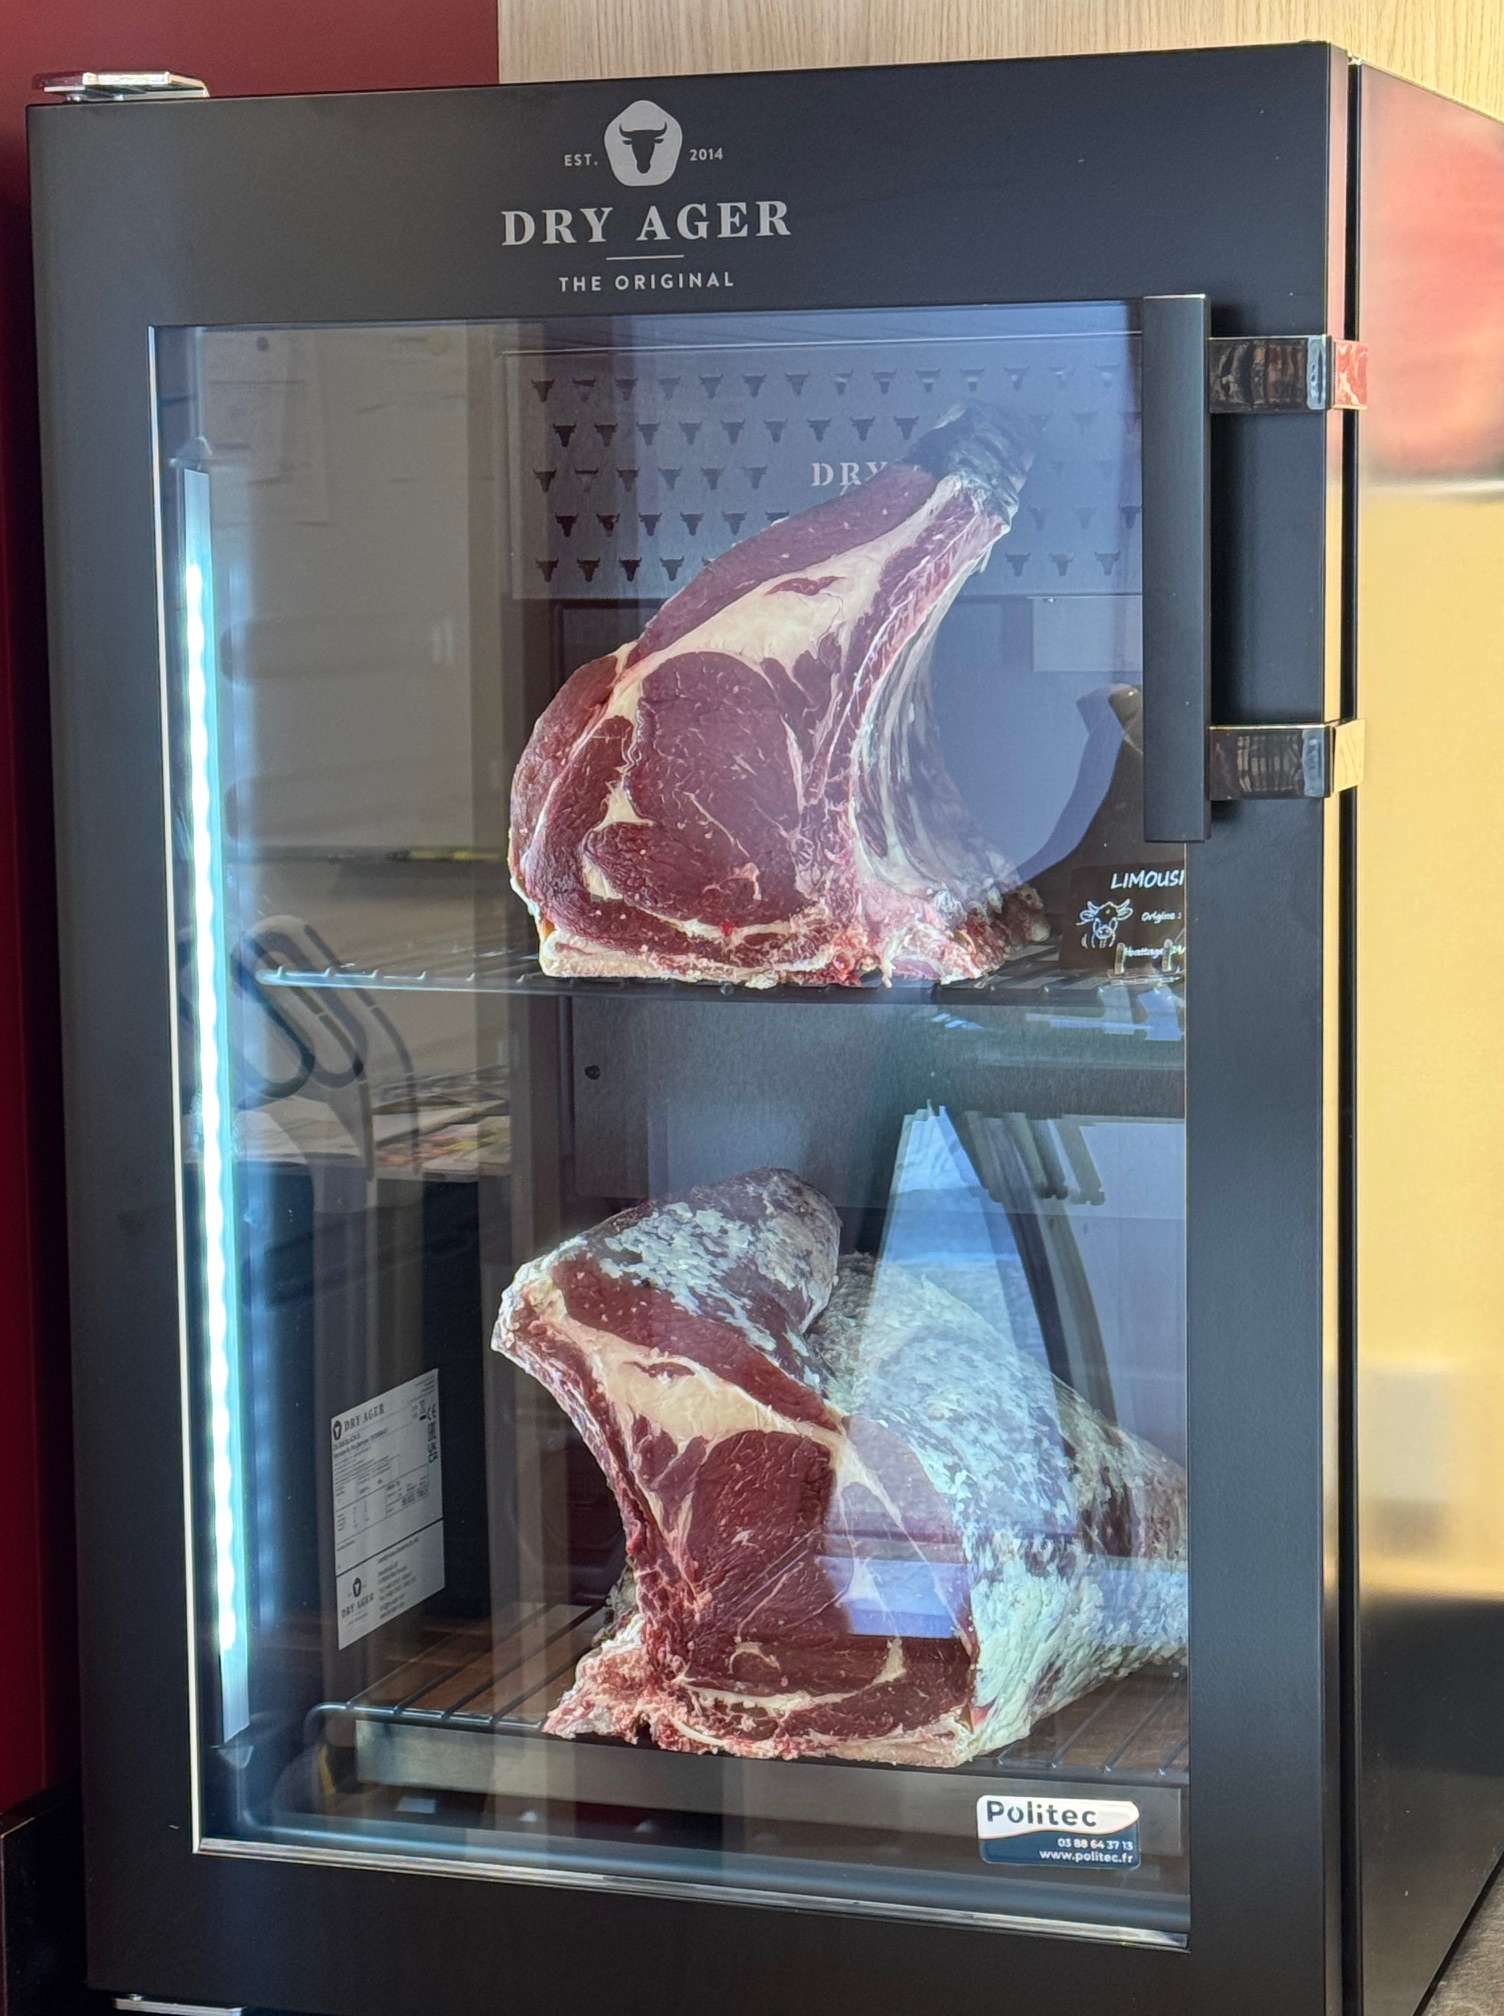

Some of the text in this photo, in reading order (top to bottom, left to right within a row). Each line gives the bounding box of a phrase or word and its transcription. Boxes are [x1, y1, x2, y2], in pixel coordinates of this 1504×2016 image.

[564, 147, 724, 167] EST. 2014
[500, 199, 792, 246] DRY AGER
[558, 271, 734, 293] THE ORIGINAL
[810, 461, 888, 487] DRY
[1141, 911, 1176, 924] Origine
[343, 1403, 386, 1433] DRY AGER
[986, 1800, 1097, 1827] Politec
[1057, 1837, 1072, 1848] 03
[1073, 1838, 1089, 1849] 88
[1090, 1839, 1105, 1850] 64
[1106, 1840, 1120, 1850] 37
[1039, 1850, 1134, 1864] www.politec.fr
